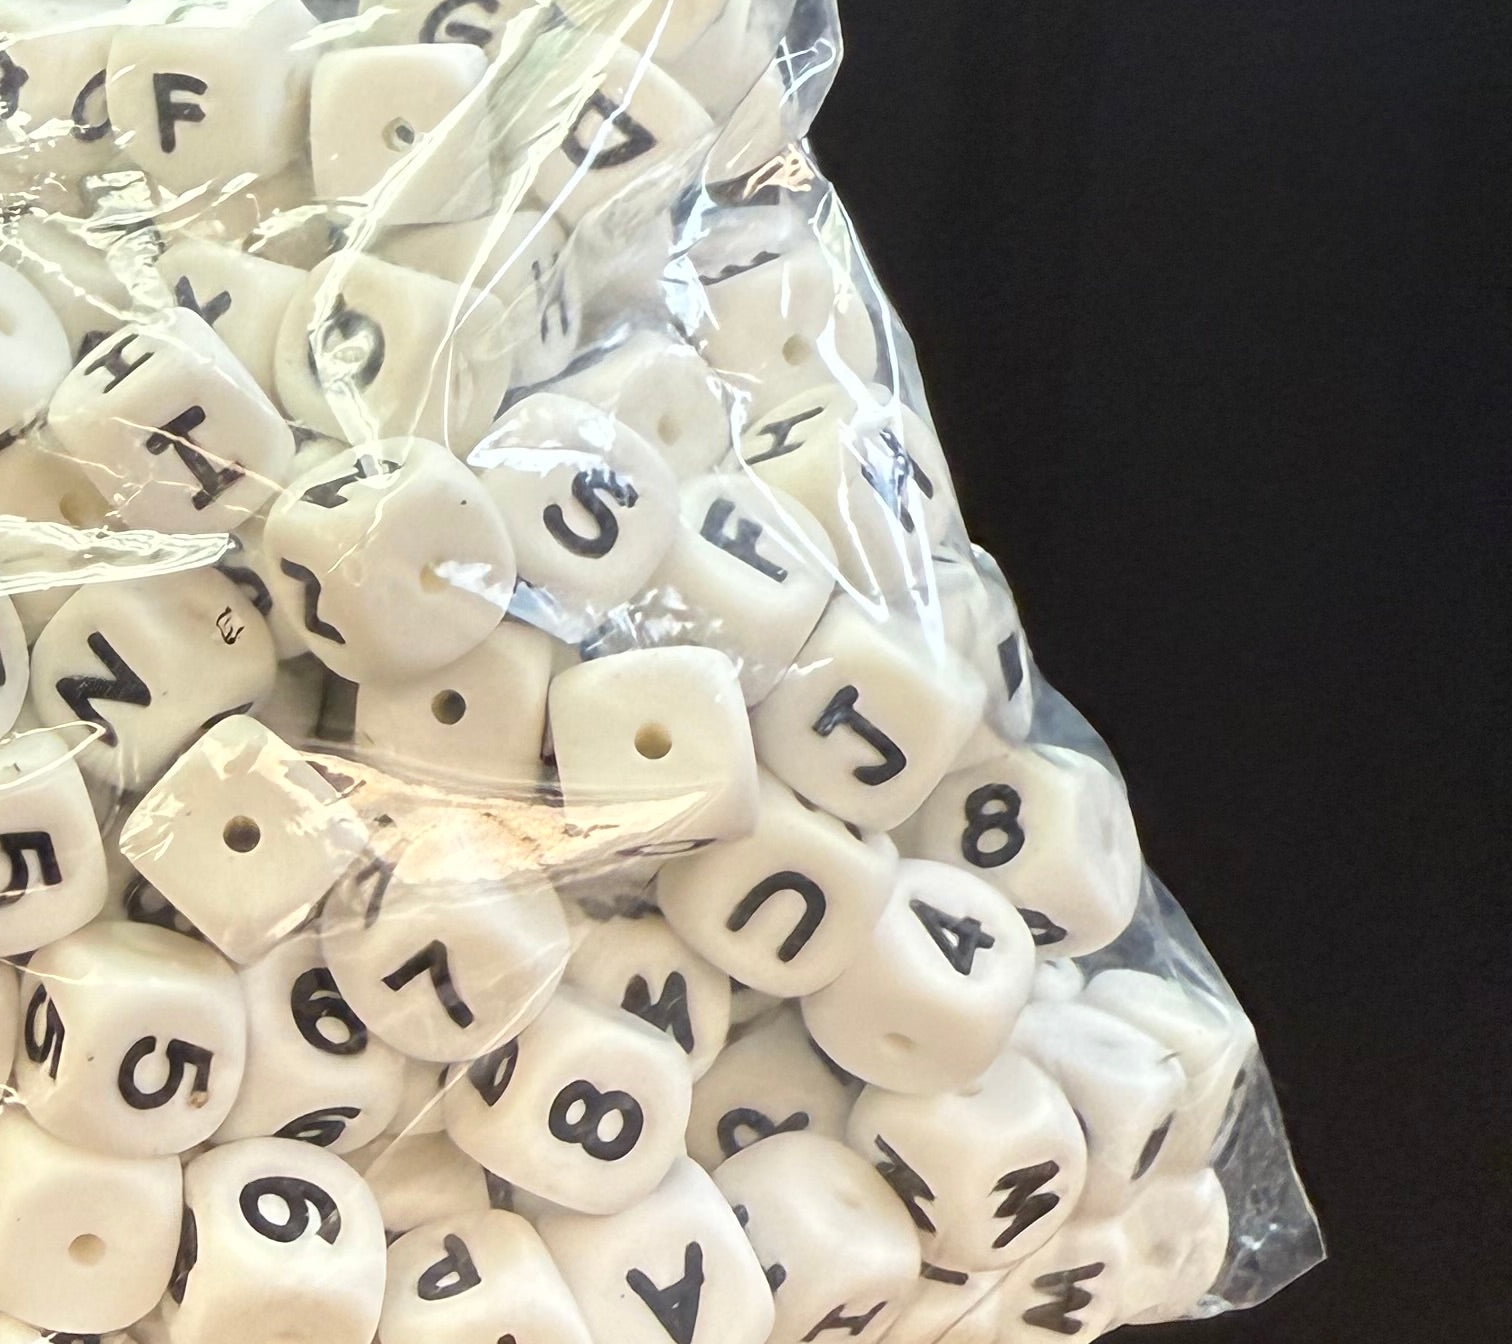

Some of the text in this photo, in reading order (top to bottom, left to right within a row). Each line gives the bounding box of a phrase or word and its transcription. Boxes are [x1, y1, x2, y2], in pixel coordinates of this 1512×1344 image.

[153, 72, 208, 154] F
[543, 468, 638, 559] S
[700, 498, 788, 583] F
[812, 685, 907, 786] J
[962, 783, 1025, 868] 8
[726, 870, 827, 963] U
[910, 899, 995, 975] 4
[382, 939, 474, 1029] 7
[118, 1035, 214, 1111] 5
[548, 1079, 644, 1161] 8
[417, 1233, 482, 1301] P
